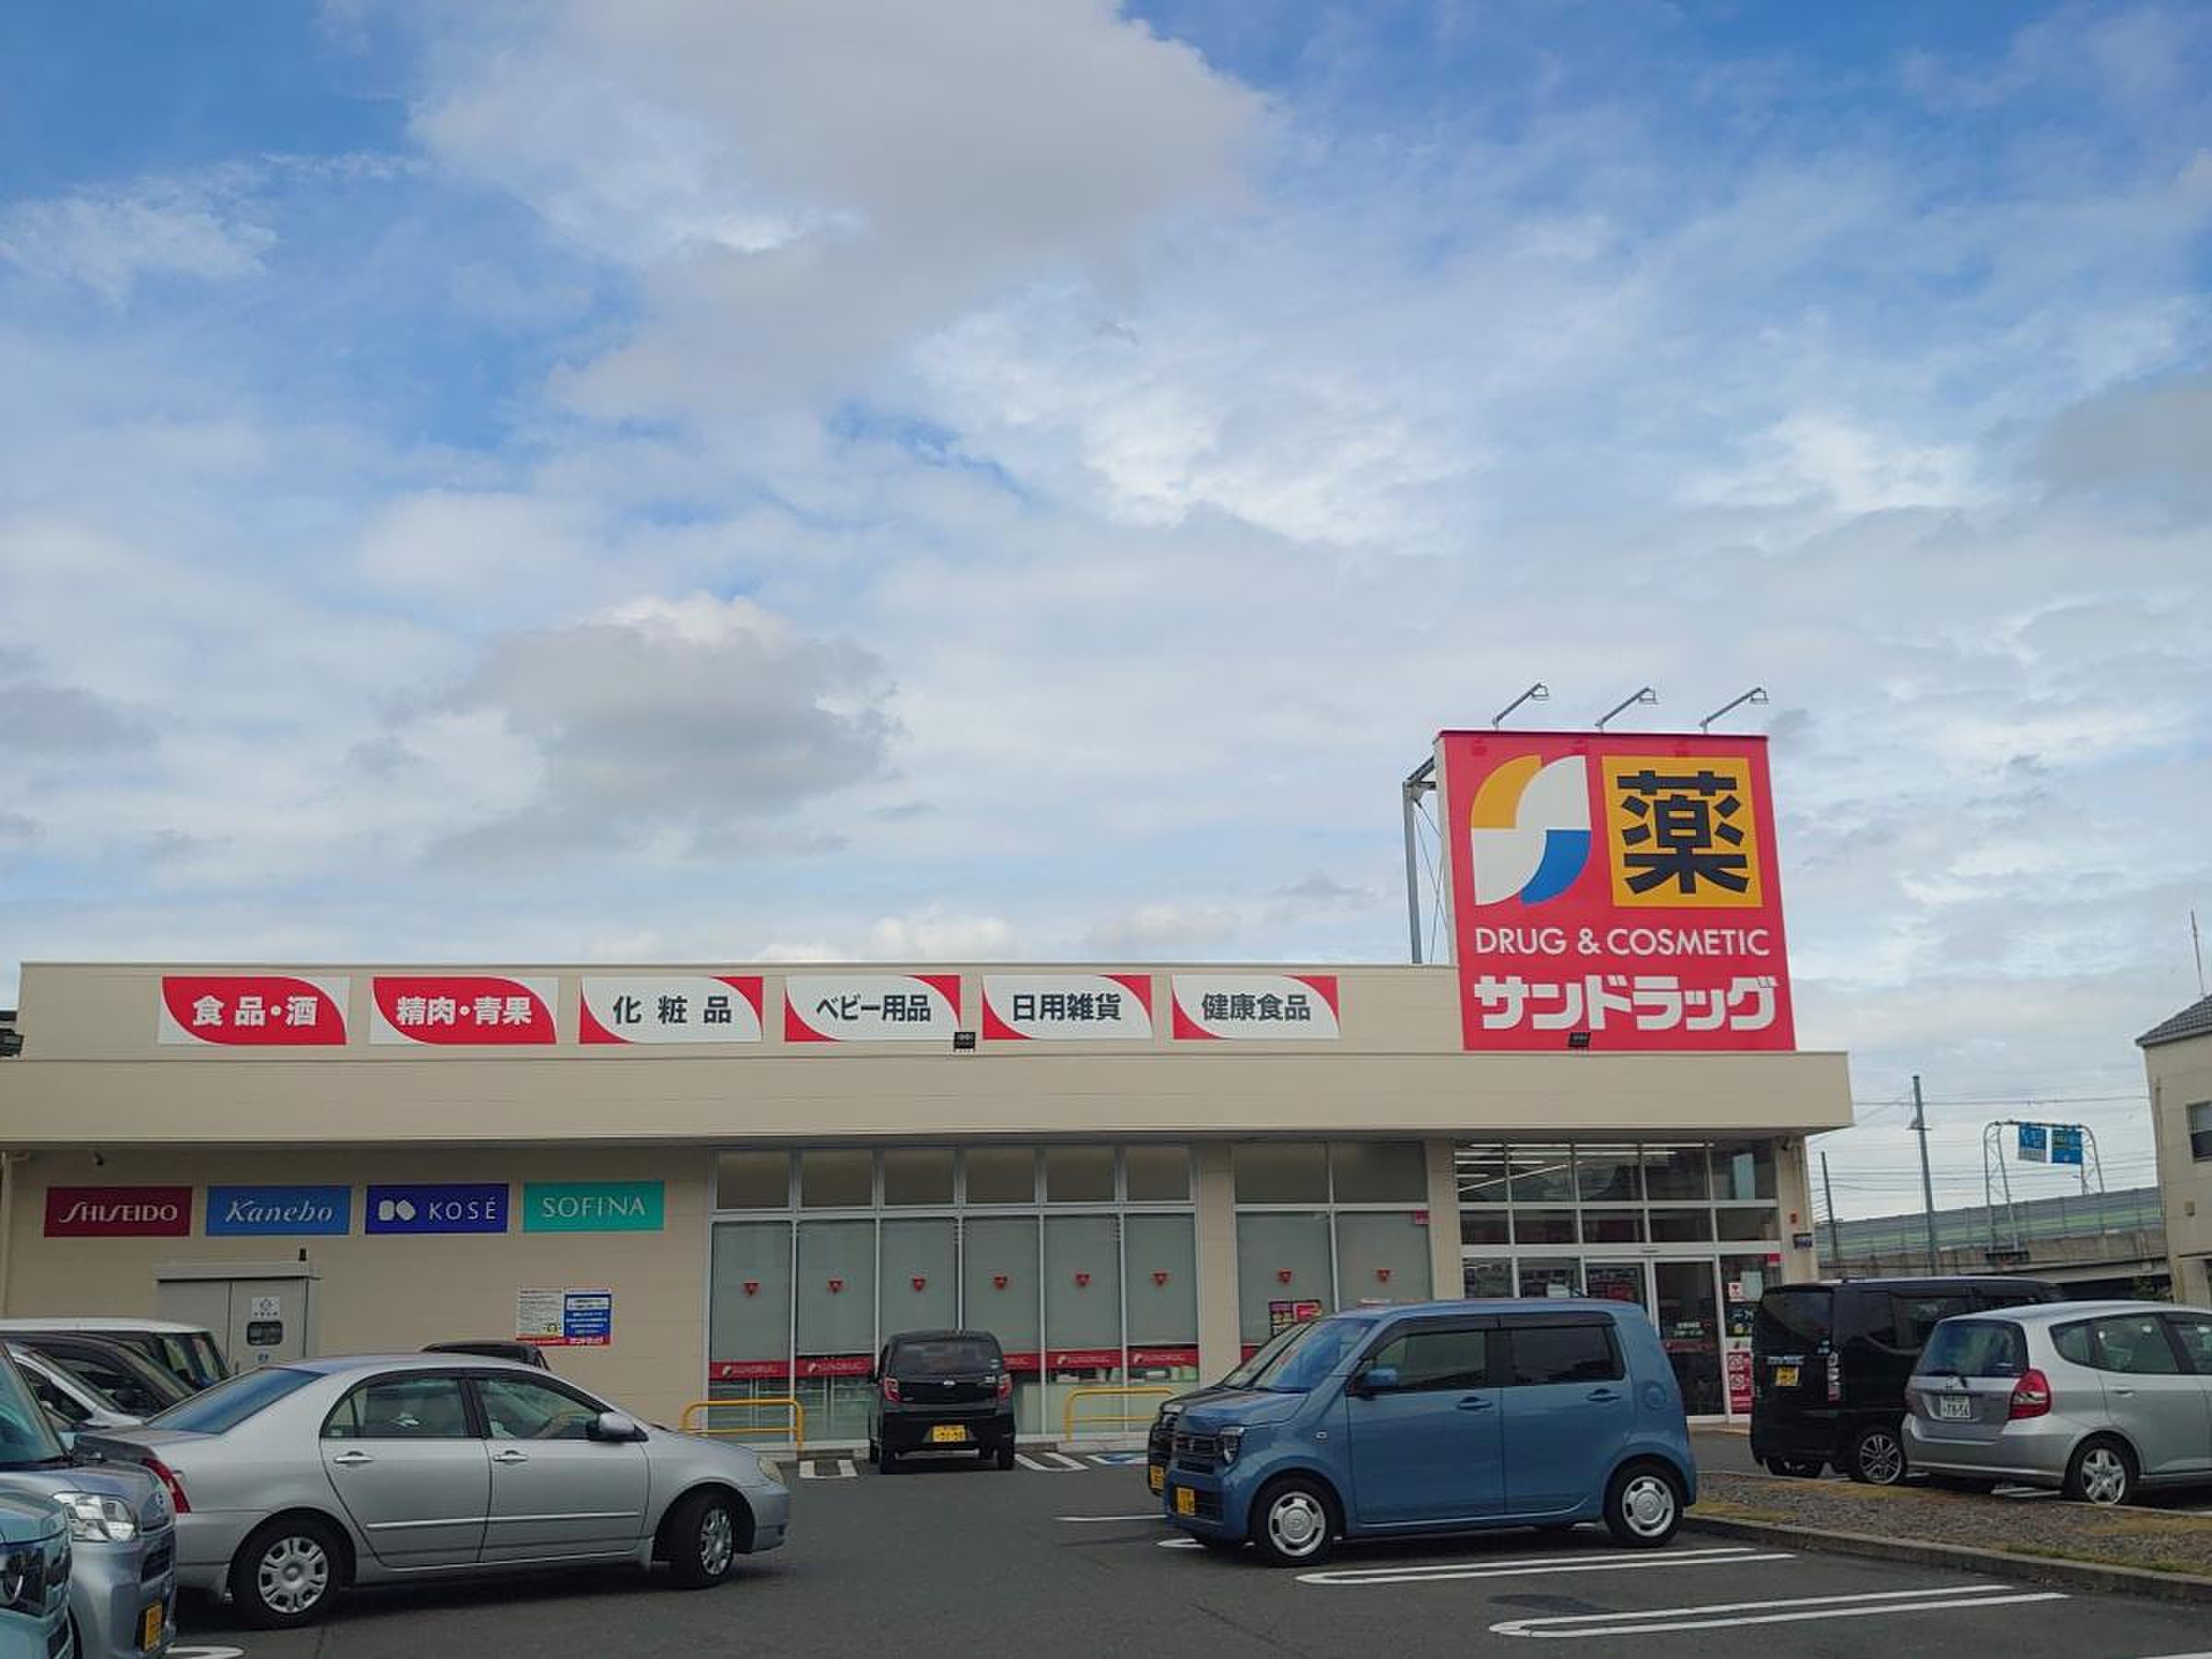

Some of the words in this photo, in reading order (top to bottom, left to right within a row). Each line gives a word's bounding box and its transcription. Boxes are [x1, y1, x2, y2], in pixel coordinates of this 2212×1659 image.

[1617, 771, 1750, 894] 薬
[1475, 928, 1567, 955] DRUG
[1578, 929, 1601, 955] &
[1607, 928, 1770, 955] COSMETIC
[192, 995, 318, 1026] 食品・酒
[396, 996, 532, 1026] 精肉・青果
[613, 995, 732, 1024] 化粧品
[816, 994, 932, 1022] ベビー用品
[1012, 994, 1122, 1021] 日用雑貨
[1201, 994, 1312, 1021] 健康食品
[1475, 975, 1777, 1030] サンドラッグ
[59, 1201, 178, 1223] SHISEIDO
[225, 1198, 334, 1222] Kanebo
[429, 1197, 497, 1220] KOSÉ
[542, 1197, 646, 1218] SOFINA
